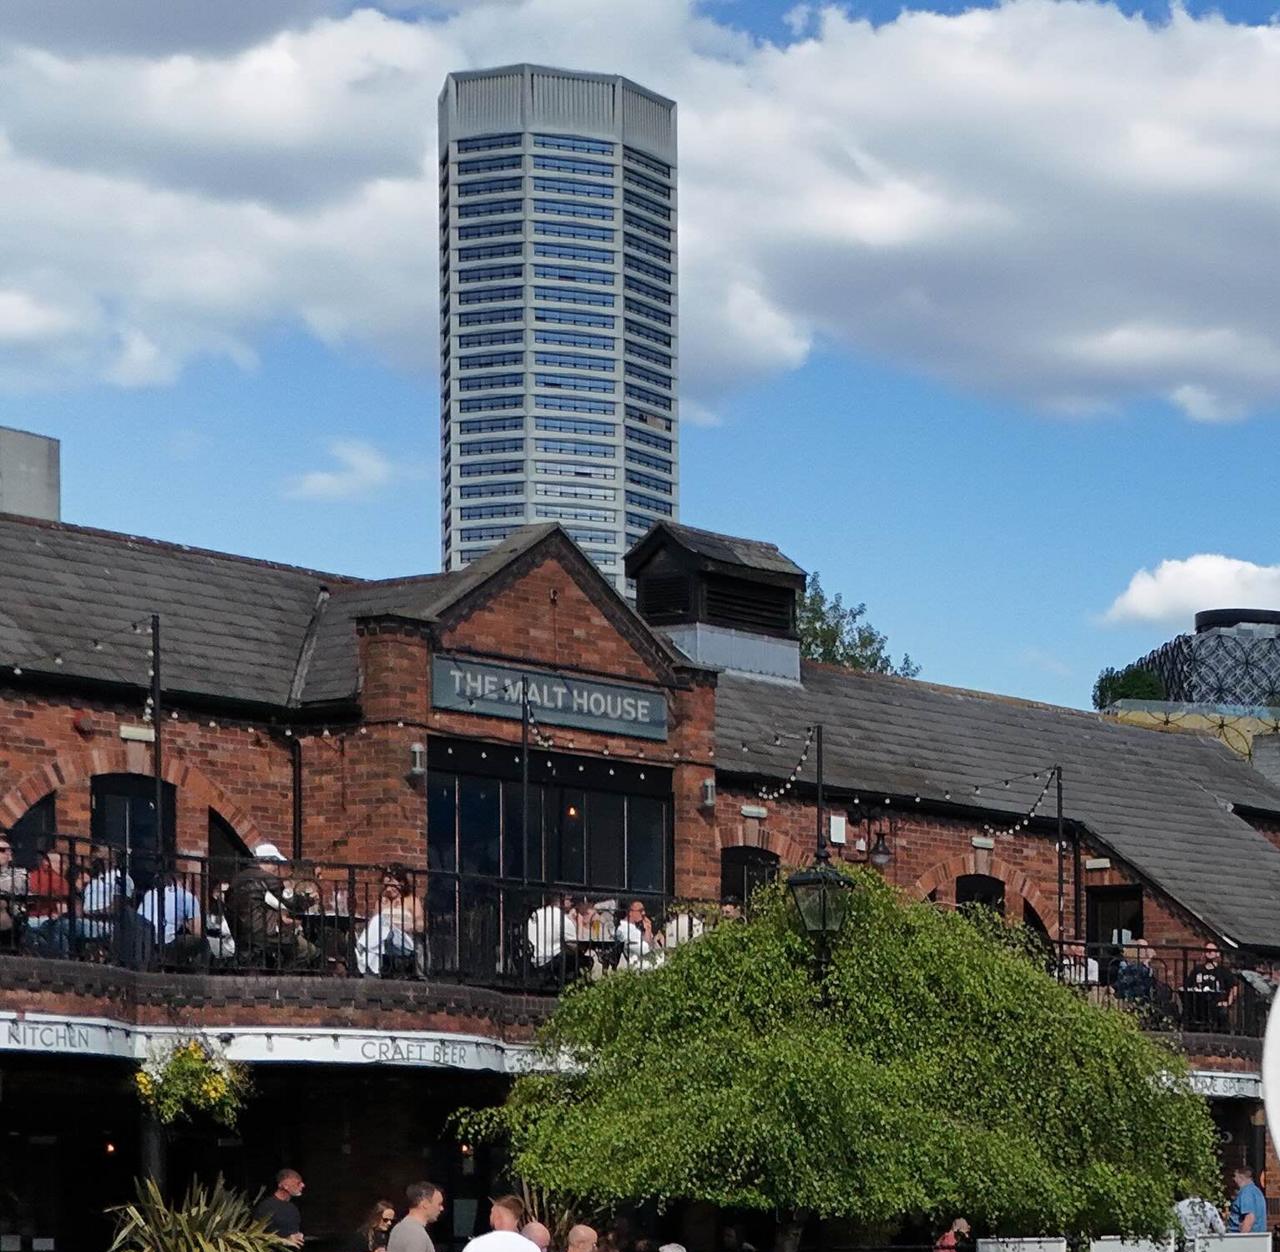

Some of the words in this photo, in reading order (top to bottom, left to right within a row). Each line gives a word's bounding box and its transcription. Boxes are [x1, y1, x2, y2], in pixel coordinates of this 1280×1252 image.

[450, 670, 498, 699] THE
[504, 679, 567, 709] MALT
[572, 690, 651, 722] HOUSE
[7, 1026, 90, 1049] KITCHEN
[361, 1041, 425, 1062] CRAFT
[433, 1045, 467, 1065] BEER
